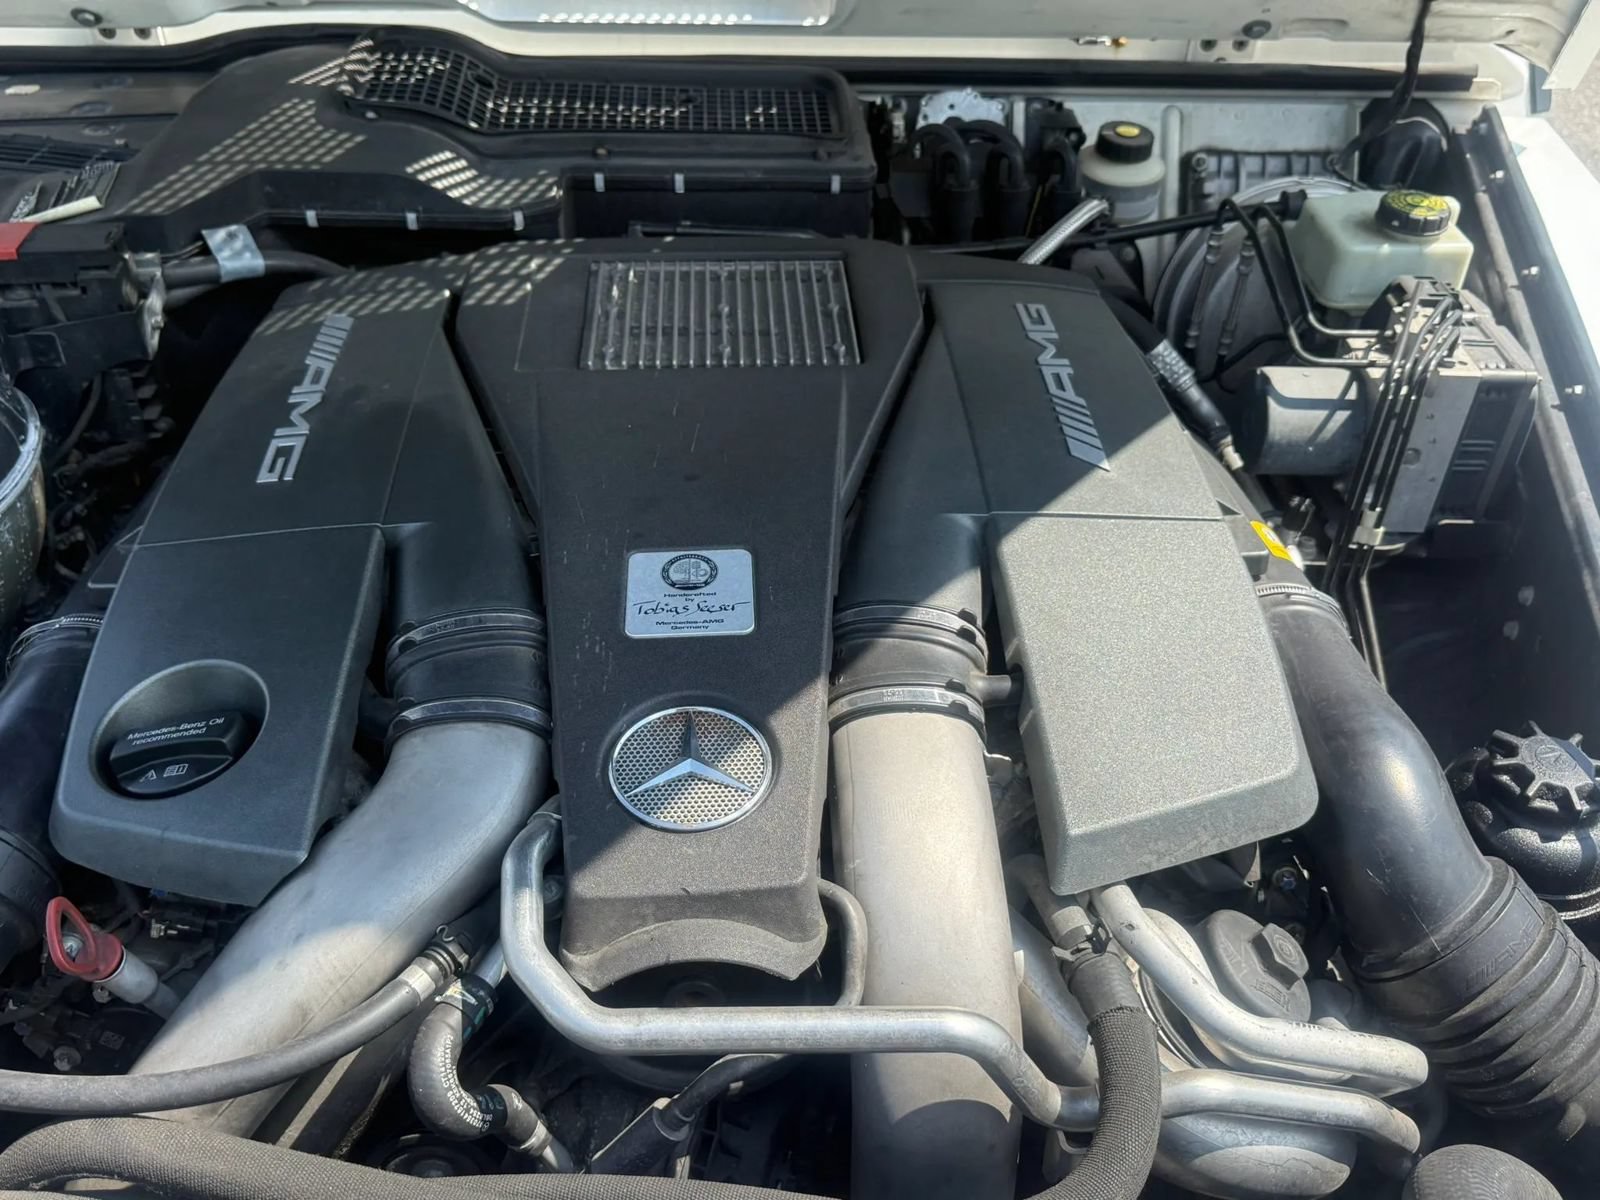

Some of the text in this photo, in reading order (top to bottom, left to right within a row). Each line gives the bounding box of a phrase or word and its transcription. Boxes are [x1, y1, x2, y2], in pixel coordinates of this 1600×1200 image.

[1016, 303, 1090, 412] AMG
[257, 353, 338, 482] AMG
[632, 600, 690, 618] Tobias
[655, 618, 725, 626] Mercedes-AMG
[127, 717, 225, 741] Mercedes-Benz Oil
[132, 727, 207, 746] recommended
